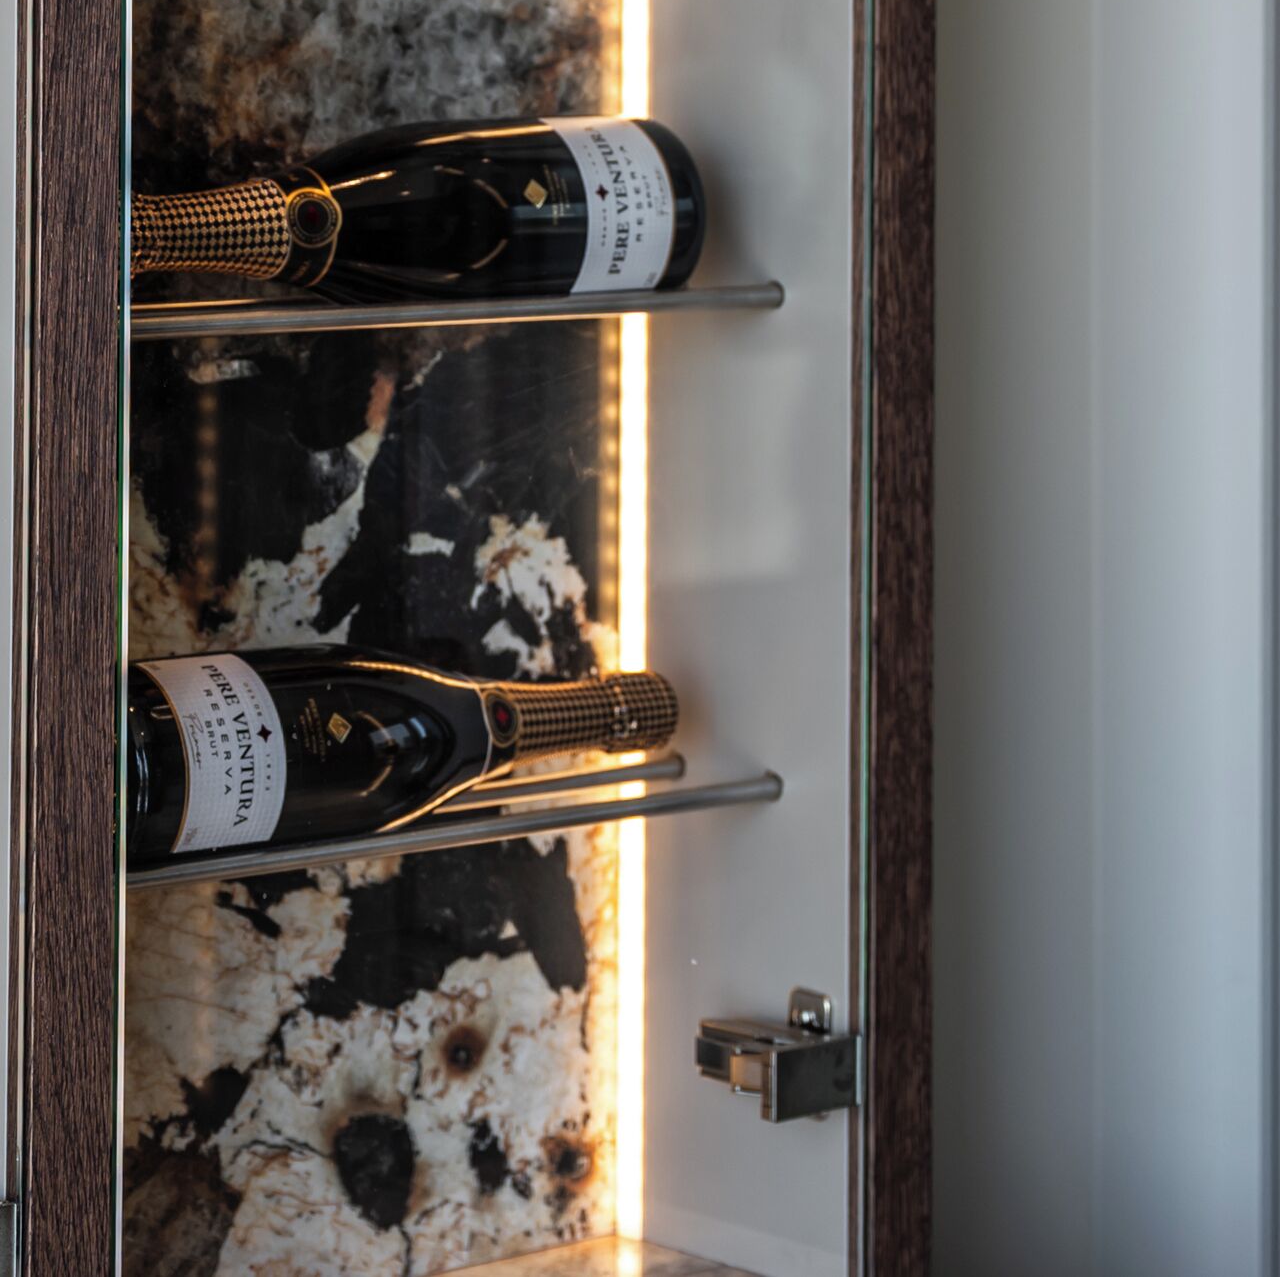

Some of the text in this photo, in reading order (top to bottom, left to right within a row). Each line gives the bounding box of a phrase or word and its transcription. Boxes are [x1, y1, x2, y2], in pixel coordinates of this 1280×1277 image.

[608, 221, 630, 275] PERE
[201, 664, 255, 827] PERE VENTURA
[204, 689, 233, 795] RESERVA
[205, 720, 218, 758] BRUT
